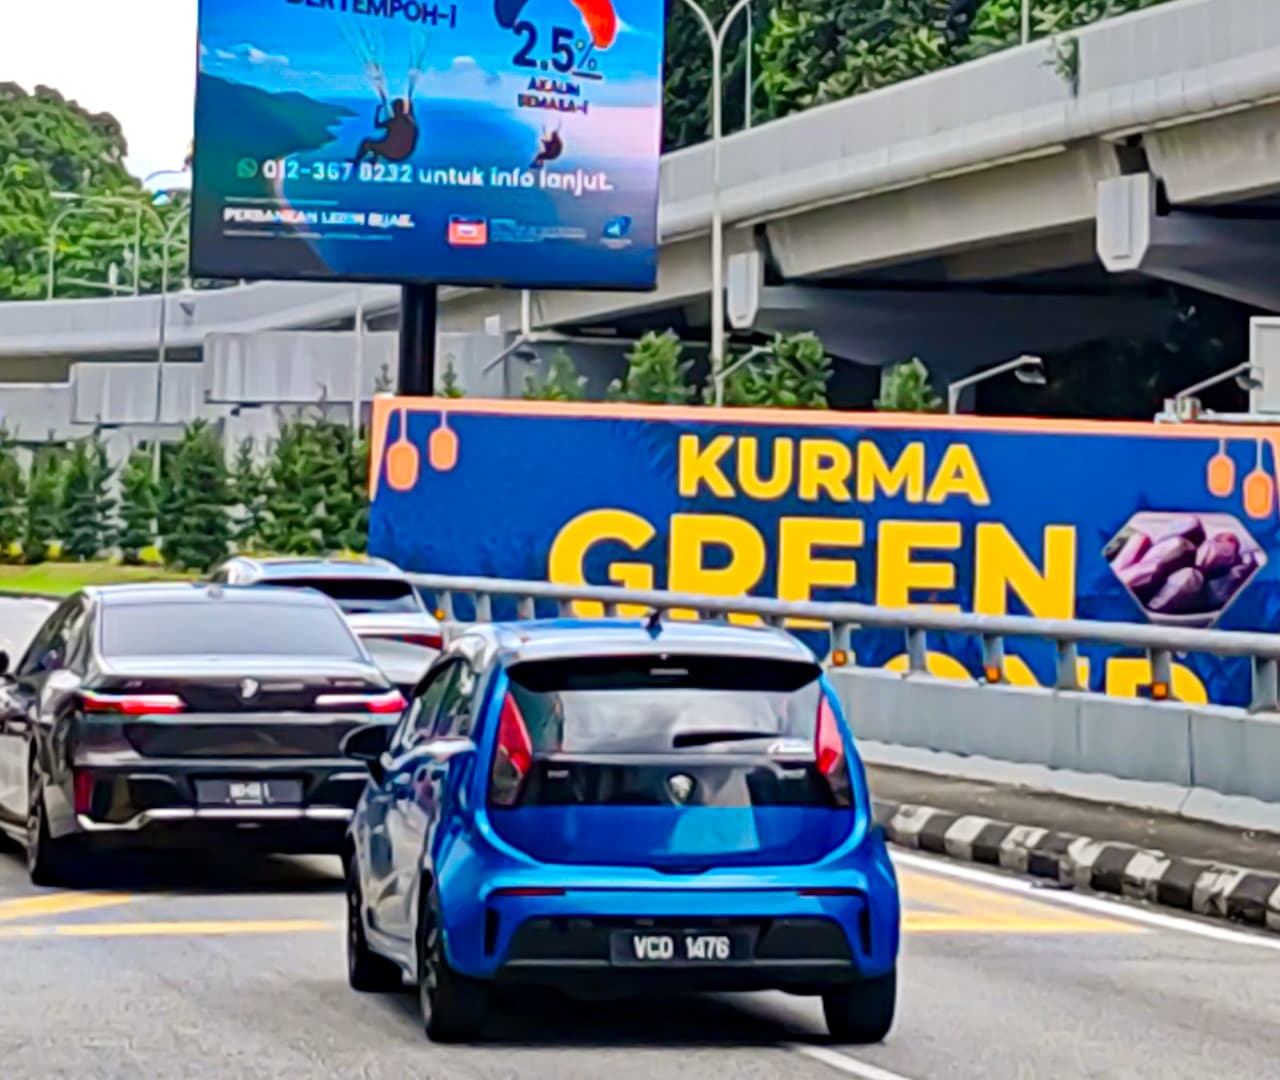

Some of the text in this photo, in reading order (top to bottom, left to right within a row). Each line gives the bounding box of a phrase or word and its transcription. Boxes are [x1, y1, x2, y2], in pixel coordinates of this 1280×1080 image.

[512, 21, 599, 74] 2.5%
[262, 159, 354, 182] 012-367
[419, 168, 484, 187] untuk
[490, 167, 535, 189] info
[677, 433, 991, 506] KURMA
[547, 507, 1078, 630] GREEN
[633, 936, 730, 960] VCD 1476
